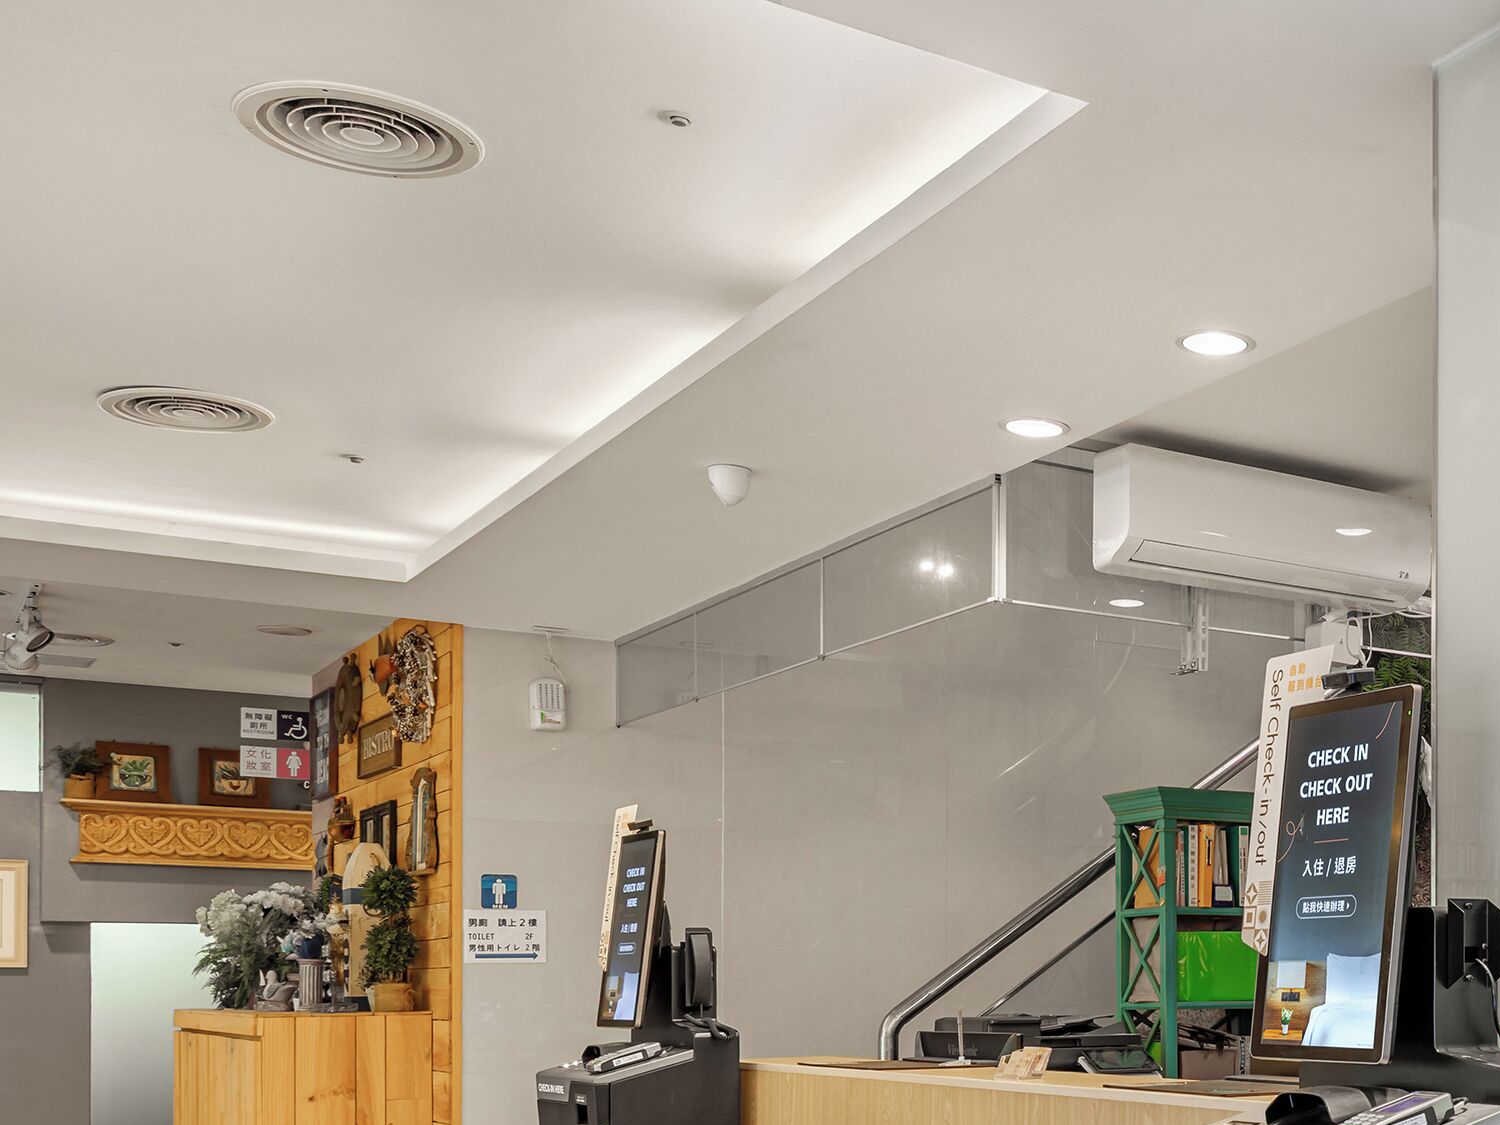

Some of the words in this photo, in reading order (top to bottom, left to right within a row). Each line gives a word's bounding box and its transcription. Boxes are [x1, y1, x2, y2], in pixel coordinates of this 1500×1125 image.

[1269, 669, 1283, 712] Self
[1307, 746, 1350, 768] CHECK
[1353, 743, 1369, 761] IN
[1300, 777, 1341, 798] CHECK
[1345, 773, 1373, 792] OUT
[1316, 806, 1350, 826] HERE
[626, 868, 640, 878] CHECK
[1302, 858, 1324, 877] 入住
[1333, 855, 1356, 875] 退房
[623, 884, 636, 893] CHECK
[636, 882, 645, 891] OUT
